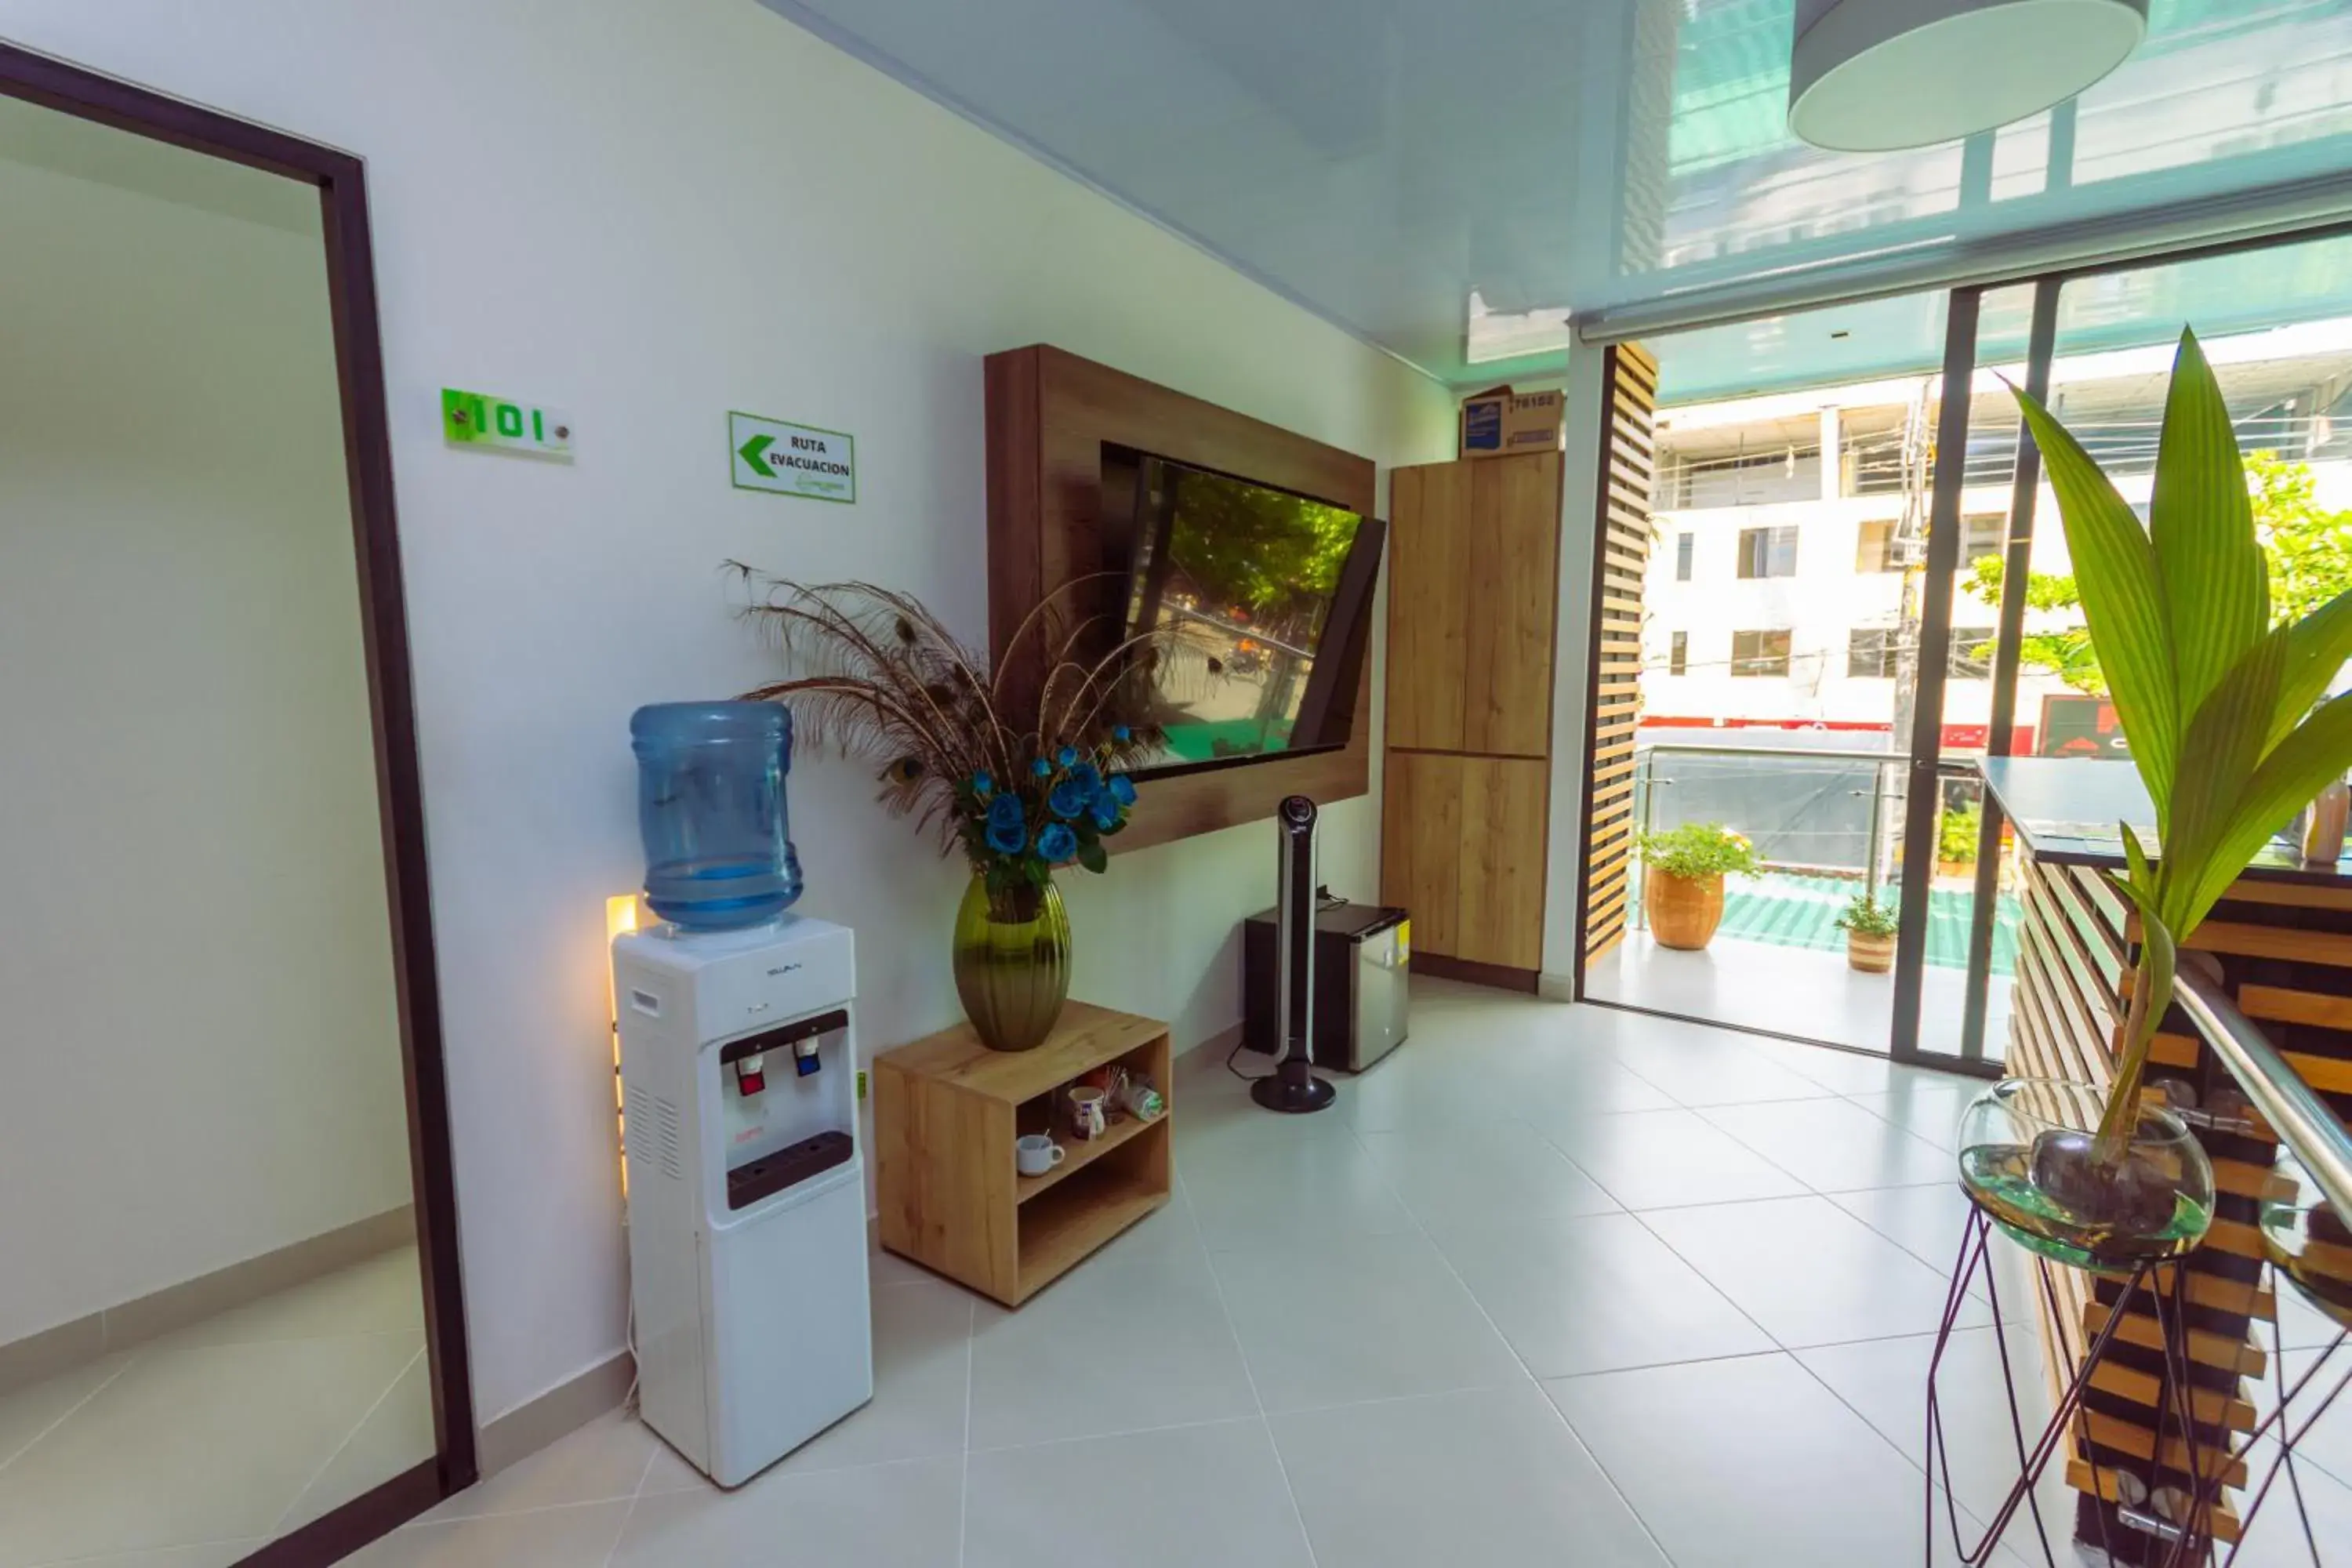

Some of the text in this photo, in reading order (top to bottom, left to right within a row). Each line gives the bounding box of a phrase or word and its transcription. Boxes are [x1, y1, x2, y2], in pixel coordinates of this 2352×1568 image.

[474, 398, 543, 441] 101
[791, 436, 826, 454] RUTA
[770, 452, 850, 477] EVACUACION
